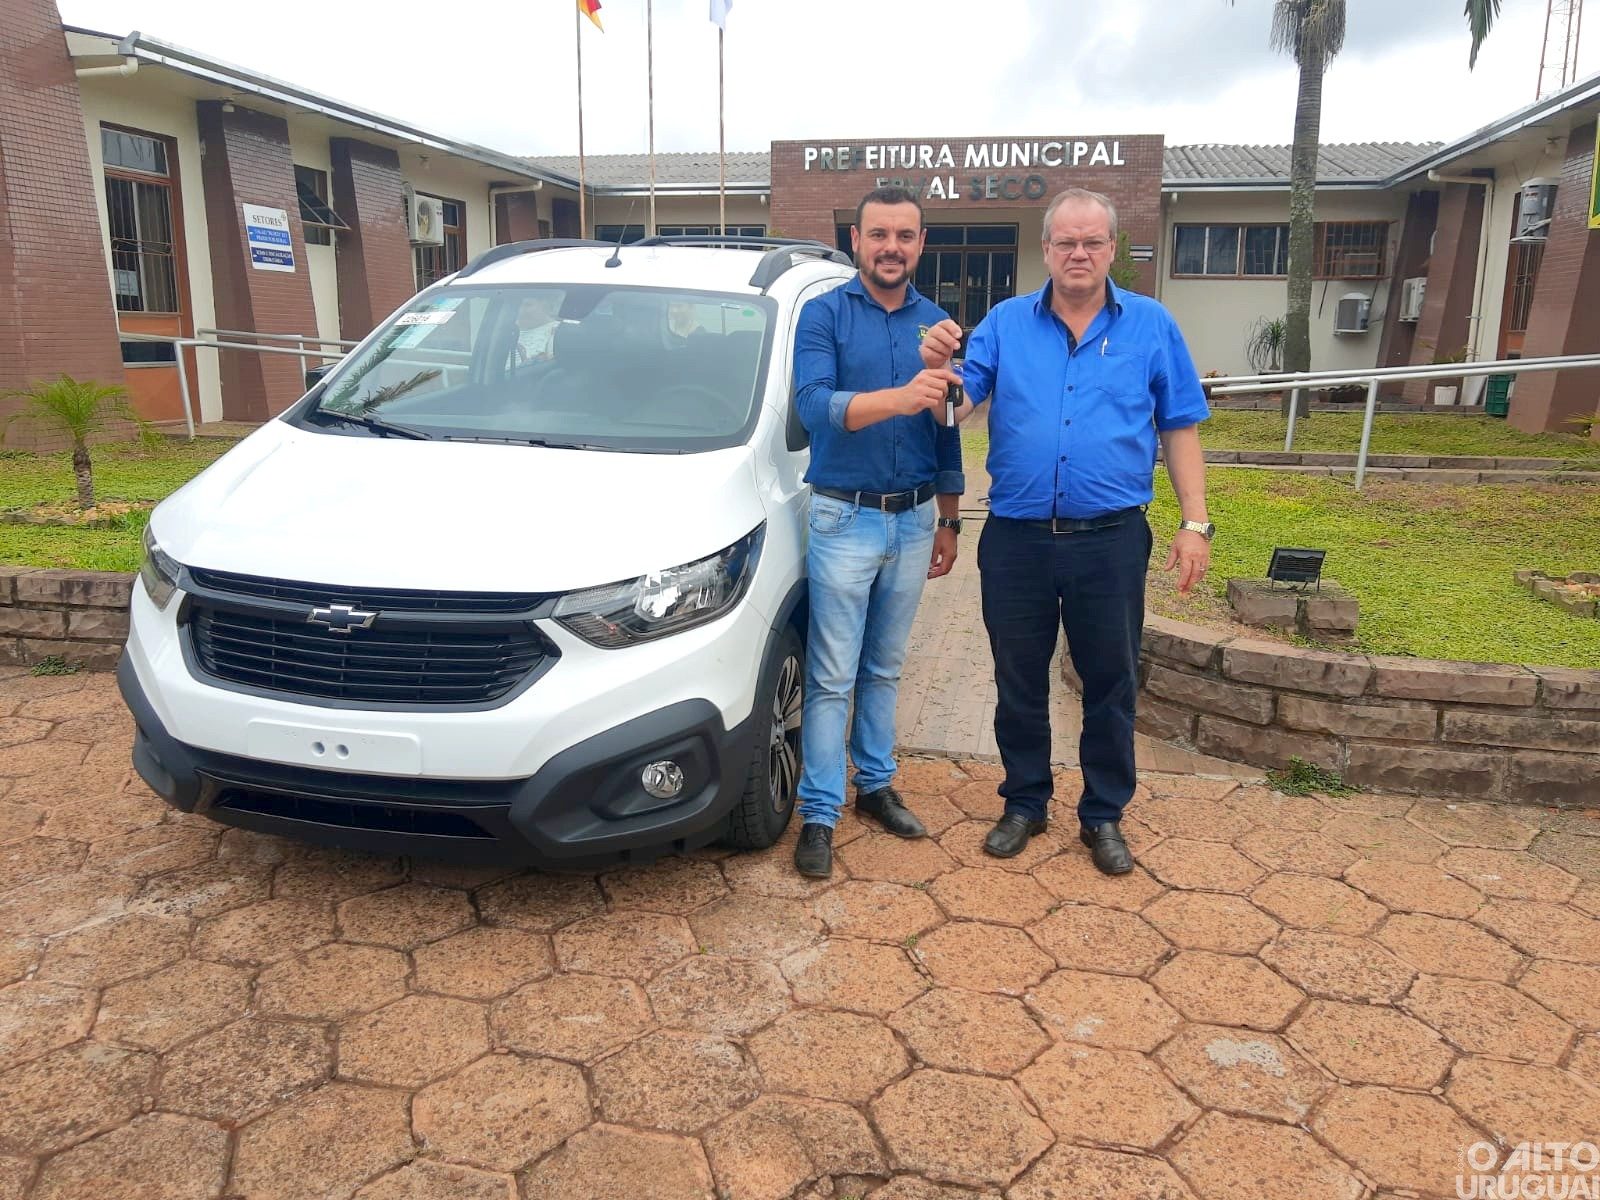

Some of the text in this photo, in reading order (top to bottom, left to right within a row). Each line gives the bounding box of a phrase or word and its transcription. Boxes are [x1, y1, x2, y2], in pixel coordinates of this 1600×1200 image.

[804, 141, 1125, 171] PREFEITURA MUNICIPAL
[970, 175, 1046, 200] SECO
[252, 214, 283, 227] SETORES
